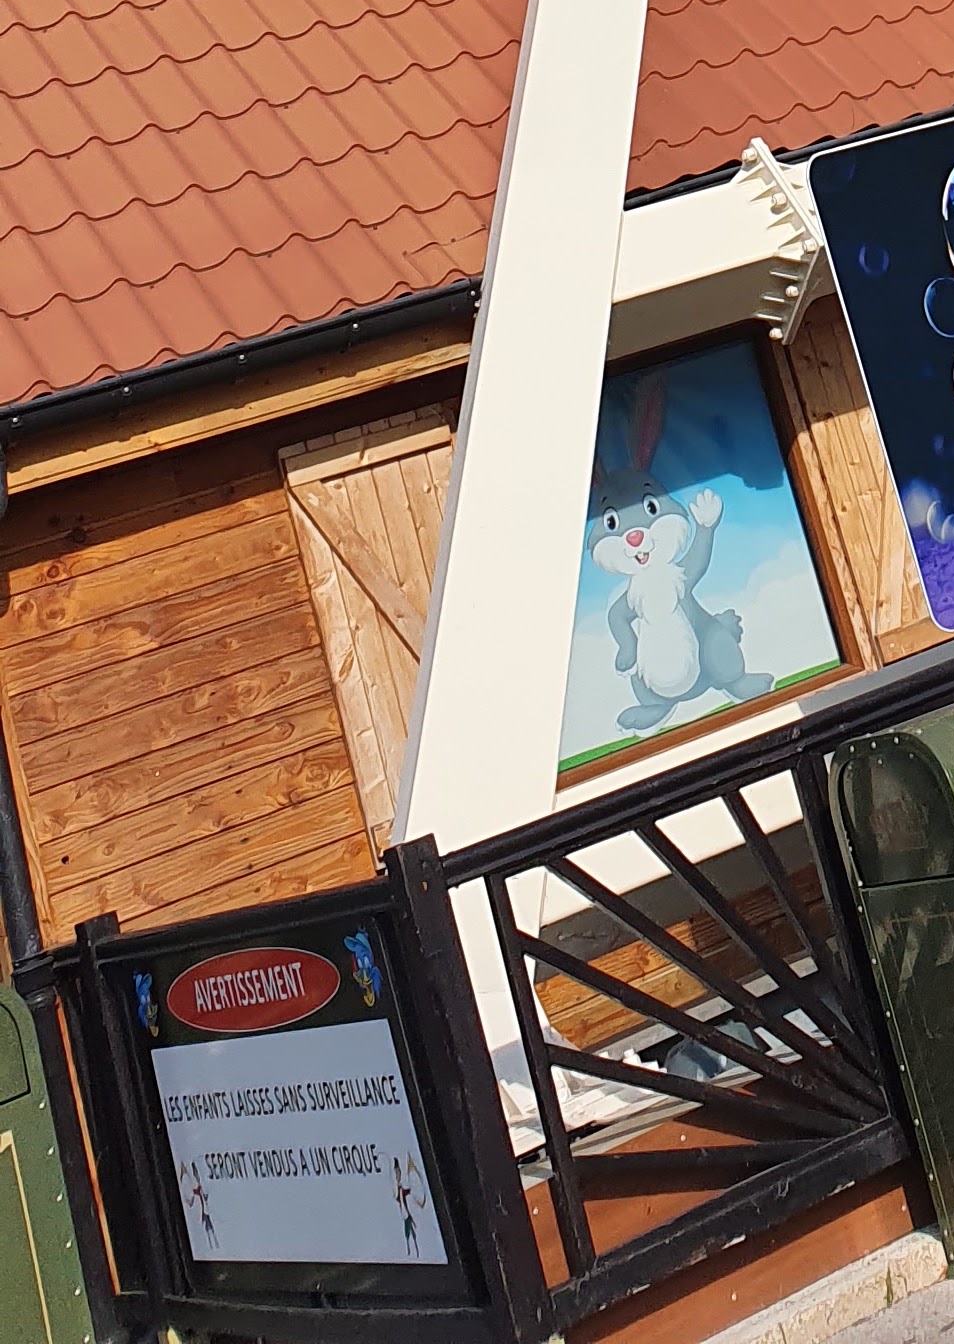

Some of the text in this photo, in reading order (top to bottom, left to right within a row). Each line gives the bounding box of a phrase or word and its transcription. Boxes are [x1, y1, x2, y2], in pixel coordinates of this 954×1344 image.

[194, 961, 306, 1013] AVERTISSEMENT
[164, 1075, 400, 1122] LES ENFANTS LAISSES SANS SURVEILLANCE
[204, 1143, 382, 1180] SERONT VENDUS A UN CIRQUE
